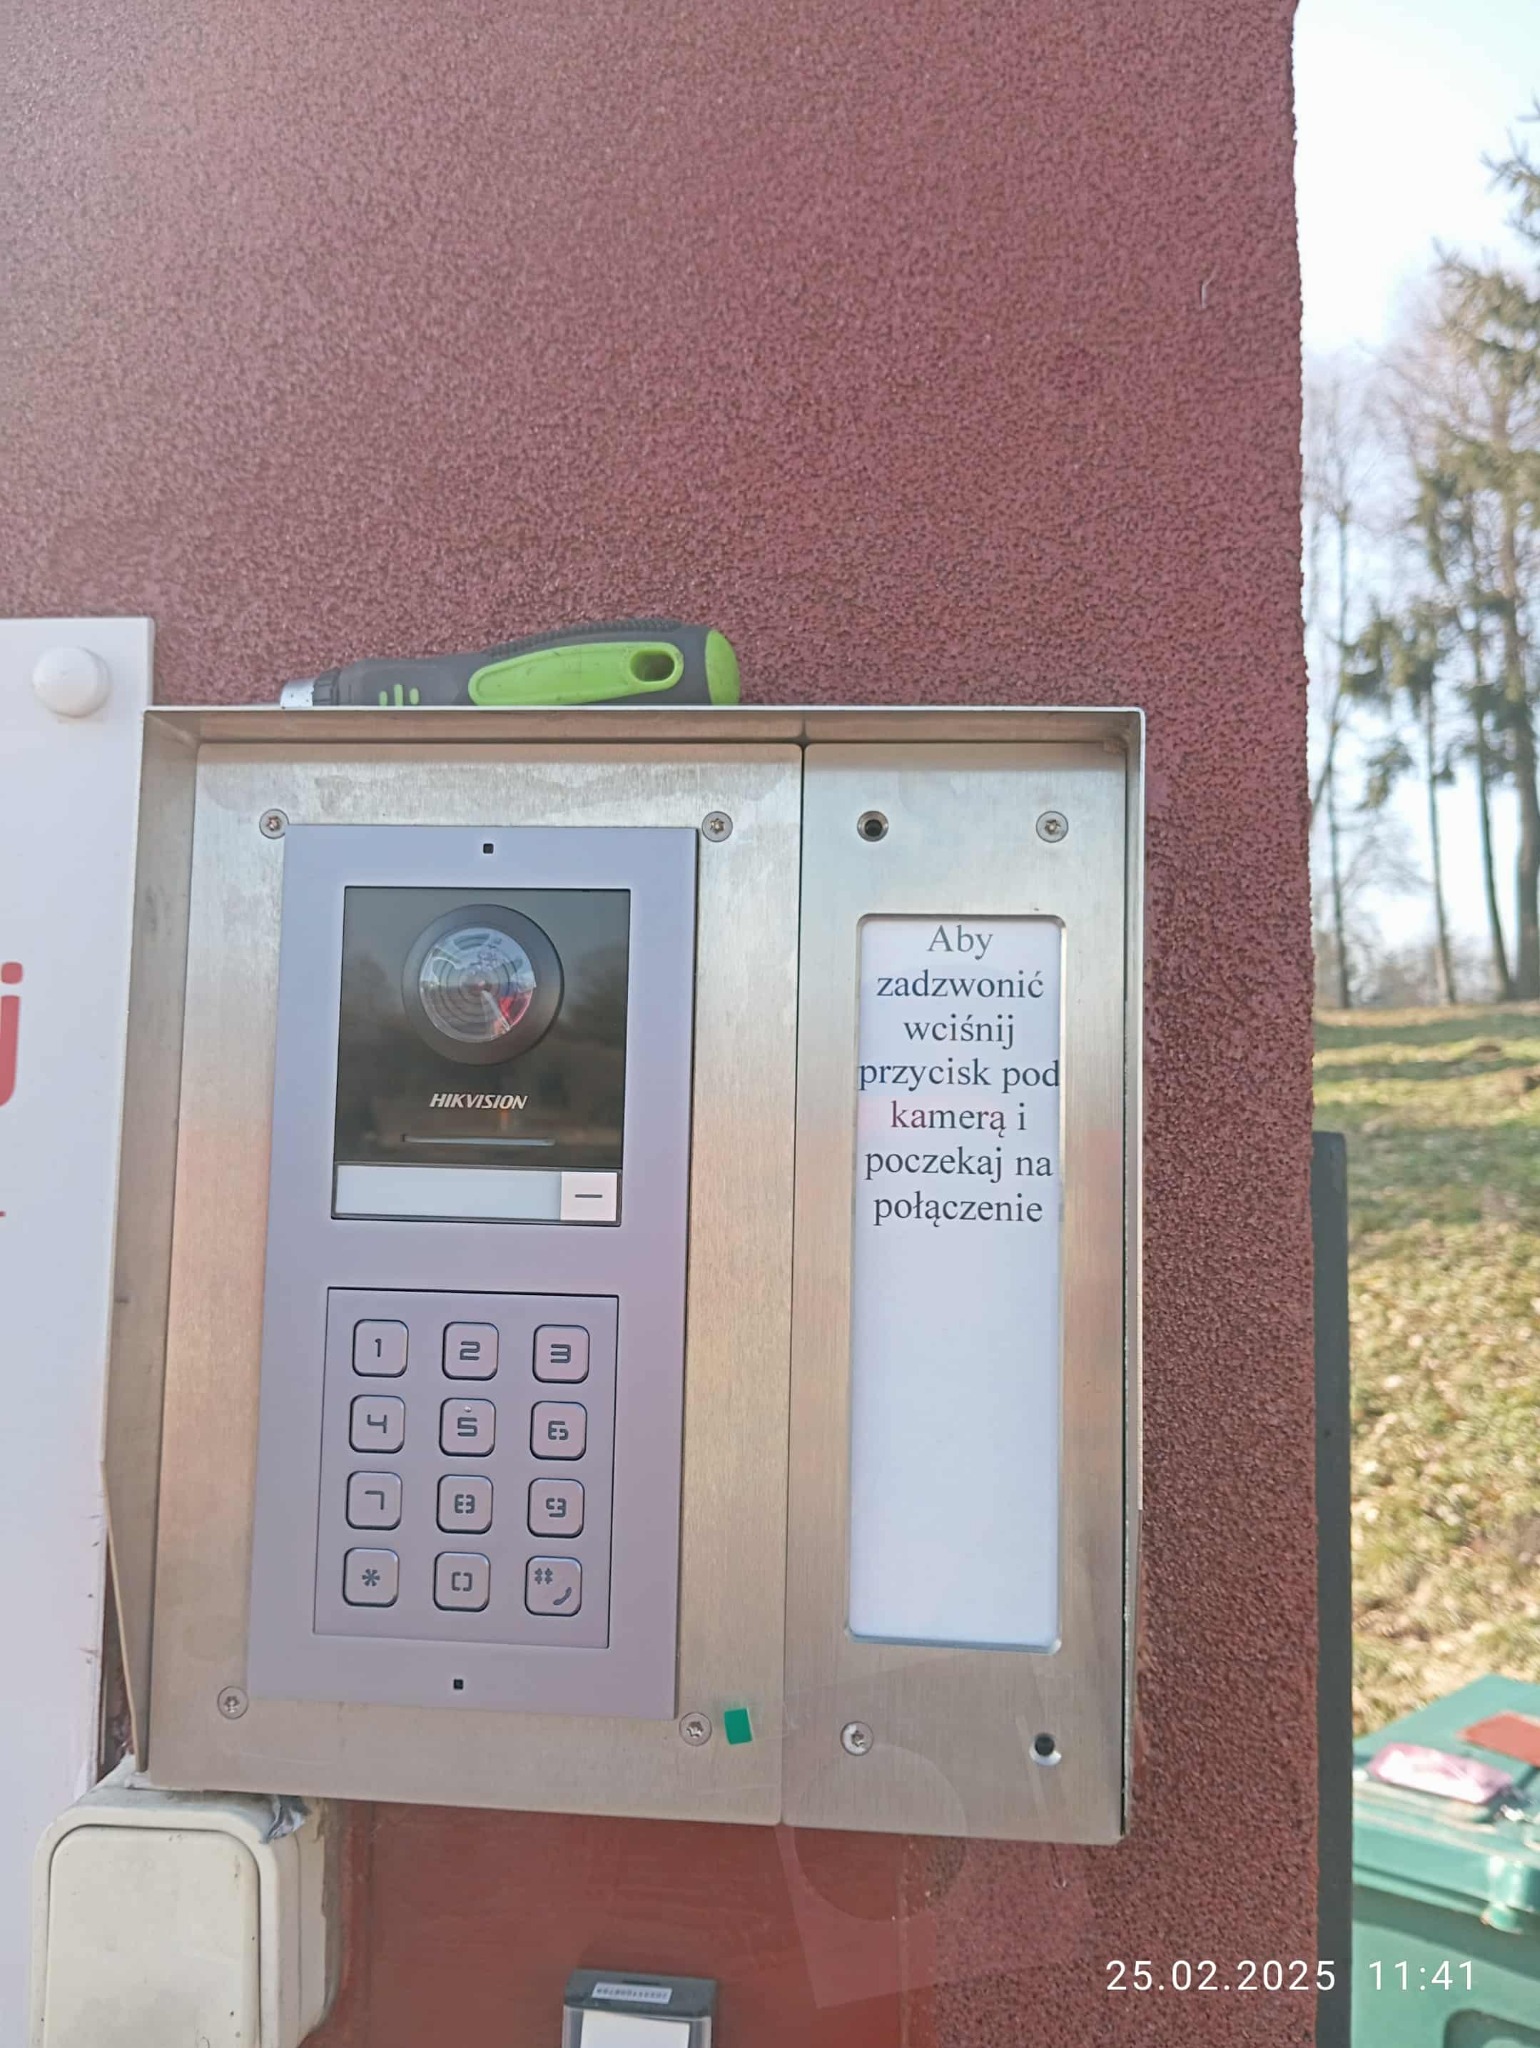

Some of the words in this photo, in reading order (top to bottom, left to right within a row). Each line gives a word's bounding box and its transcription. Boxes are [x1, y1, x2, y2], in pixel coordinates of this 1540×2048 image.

[927, 925, 993, 960] Aby
[876, 969, 1044, 998] zadzwonić
[903, 1013, 1014, 1050] wciśnij
[858, 1057, 991, 1091] przycisk
[1002, 1059, 1060, 1093] pod
[429, 1093, 528, 1110] HIKVISION
[890, 1100, 1007, 1138] kamerą
[1018, 1102, 1027, 1130] i
[865, 1146, 1002, 1184] poczekaj
[1015, 1156, 1053, 1177] na
[873, 1190, 1043, 1227] połączenie
[374, 1338, 382, 1358] 1
[459, 1340, 481, 1361] 2
[550, 1343, 572, 1364] 3
[366, 1413, 388, 1434] 4
[456, 1416, 478, 1437] 5
[547, 1420, 569, 1441] 6
[364, 1489, 385, 1511] 7
[454, 1493, 476, 1514] 8
[545, 1497, 567, 1518] 9
[451, 1571, 473, 1592] 0
